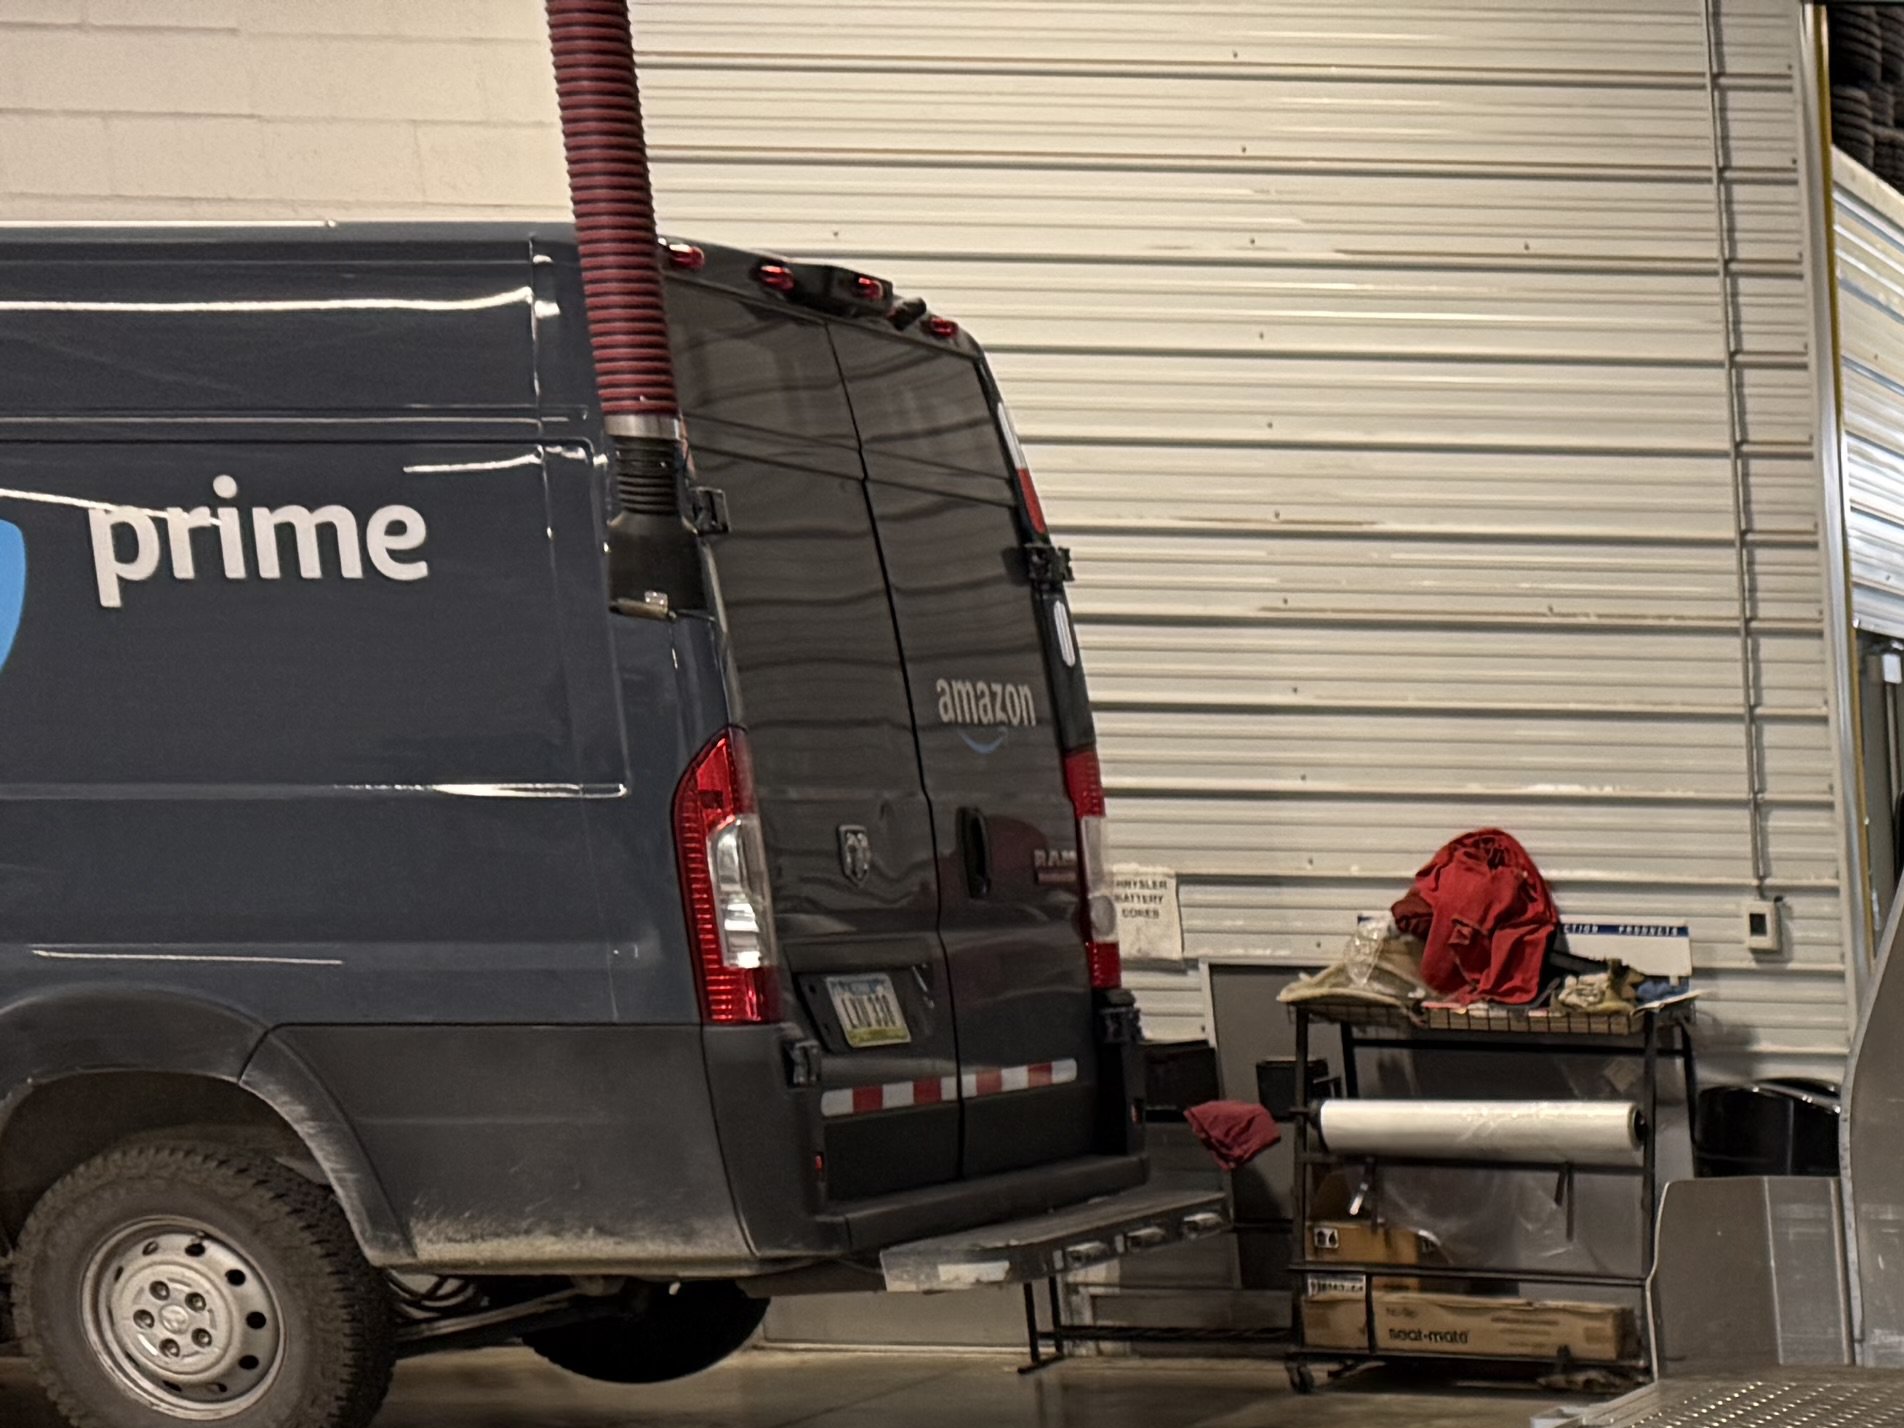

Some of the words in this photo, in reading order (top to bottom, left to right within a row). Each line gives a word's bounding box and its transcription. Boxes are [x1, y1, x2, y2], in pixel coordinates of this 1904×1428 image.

[88, 474, 430, 608] prime
[936, 677, 1037, 727] amazon
[1033, 849, 1077, 867] RAM
